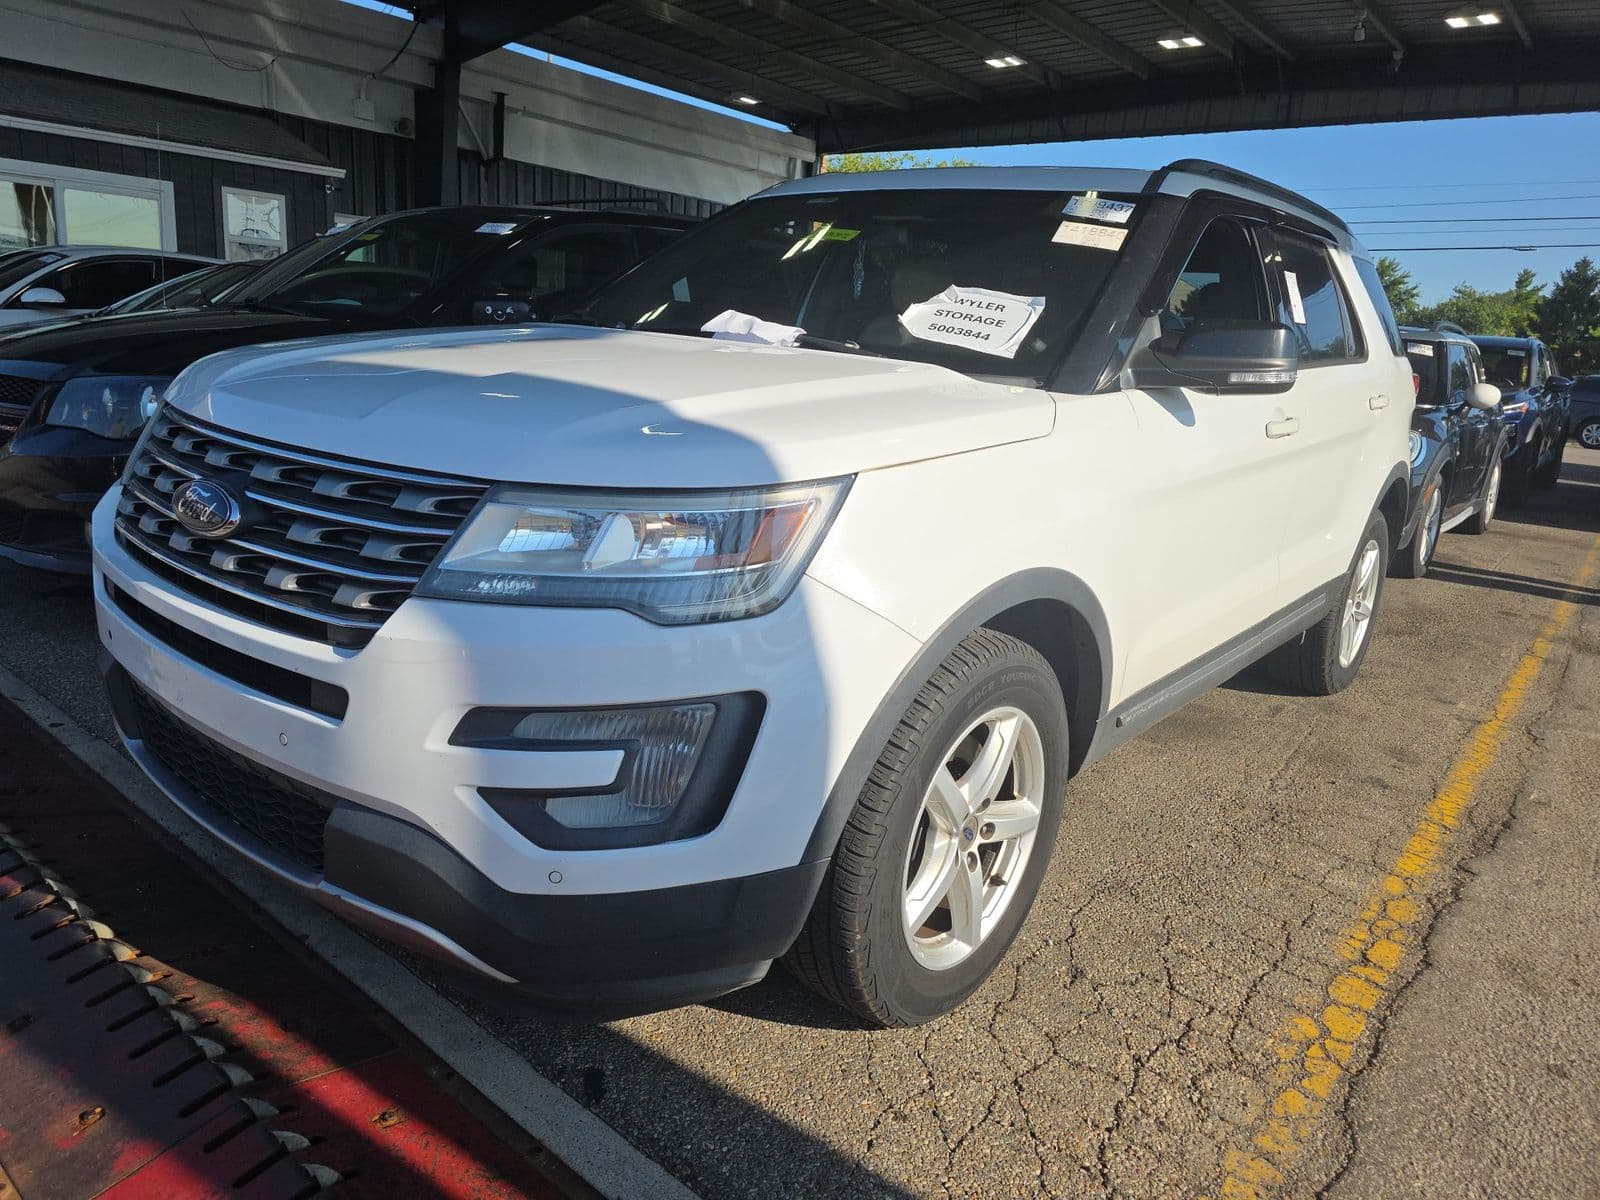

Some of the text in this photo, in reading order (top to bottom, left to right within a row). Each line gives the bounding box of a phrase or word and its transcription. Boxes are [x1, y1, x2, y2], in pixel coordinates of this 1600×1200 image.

[953, 298, 1006, 312] WYLER
[933, 309, 1007, 328] STORAGE
[927, 322, 991, 341] 5003844
[178, 485, 218, 522] Ford
